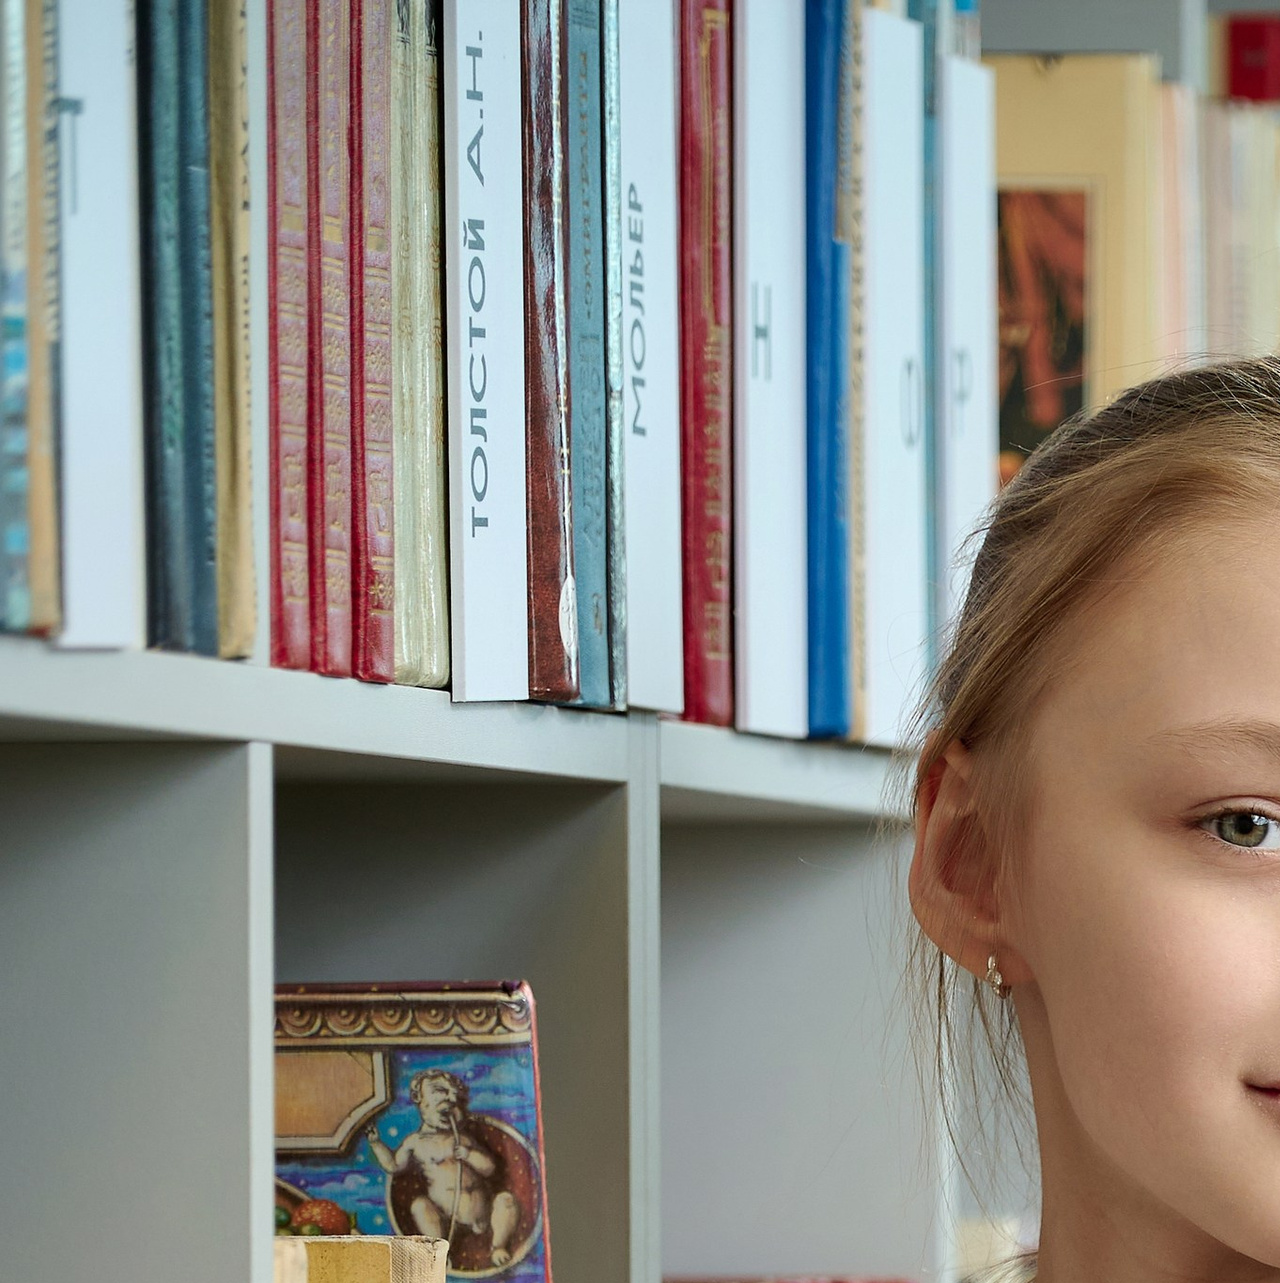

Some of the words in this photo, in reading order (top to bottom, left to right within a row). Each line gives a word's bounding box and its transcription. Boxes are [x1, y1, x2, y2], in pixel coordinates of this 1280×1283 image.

[466, 30, 486, 186] А.Н.
[463, 219, 489, 538] ТОЛСТОЙ
[628, 183, 647, 436] МОЛЬЕР
